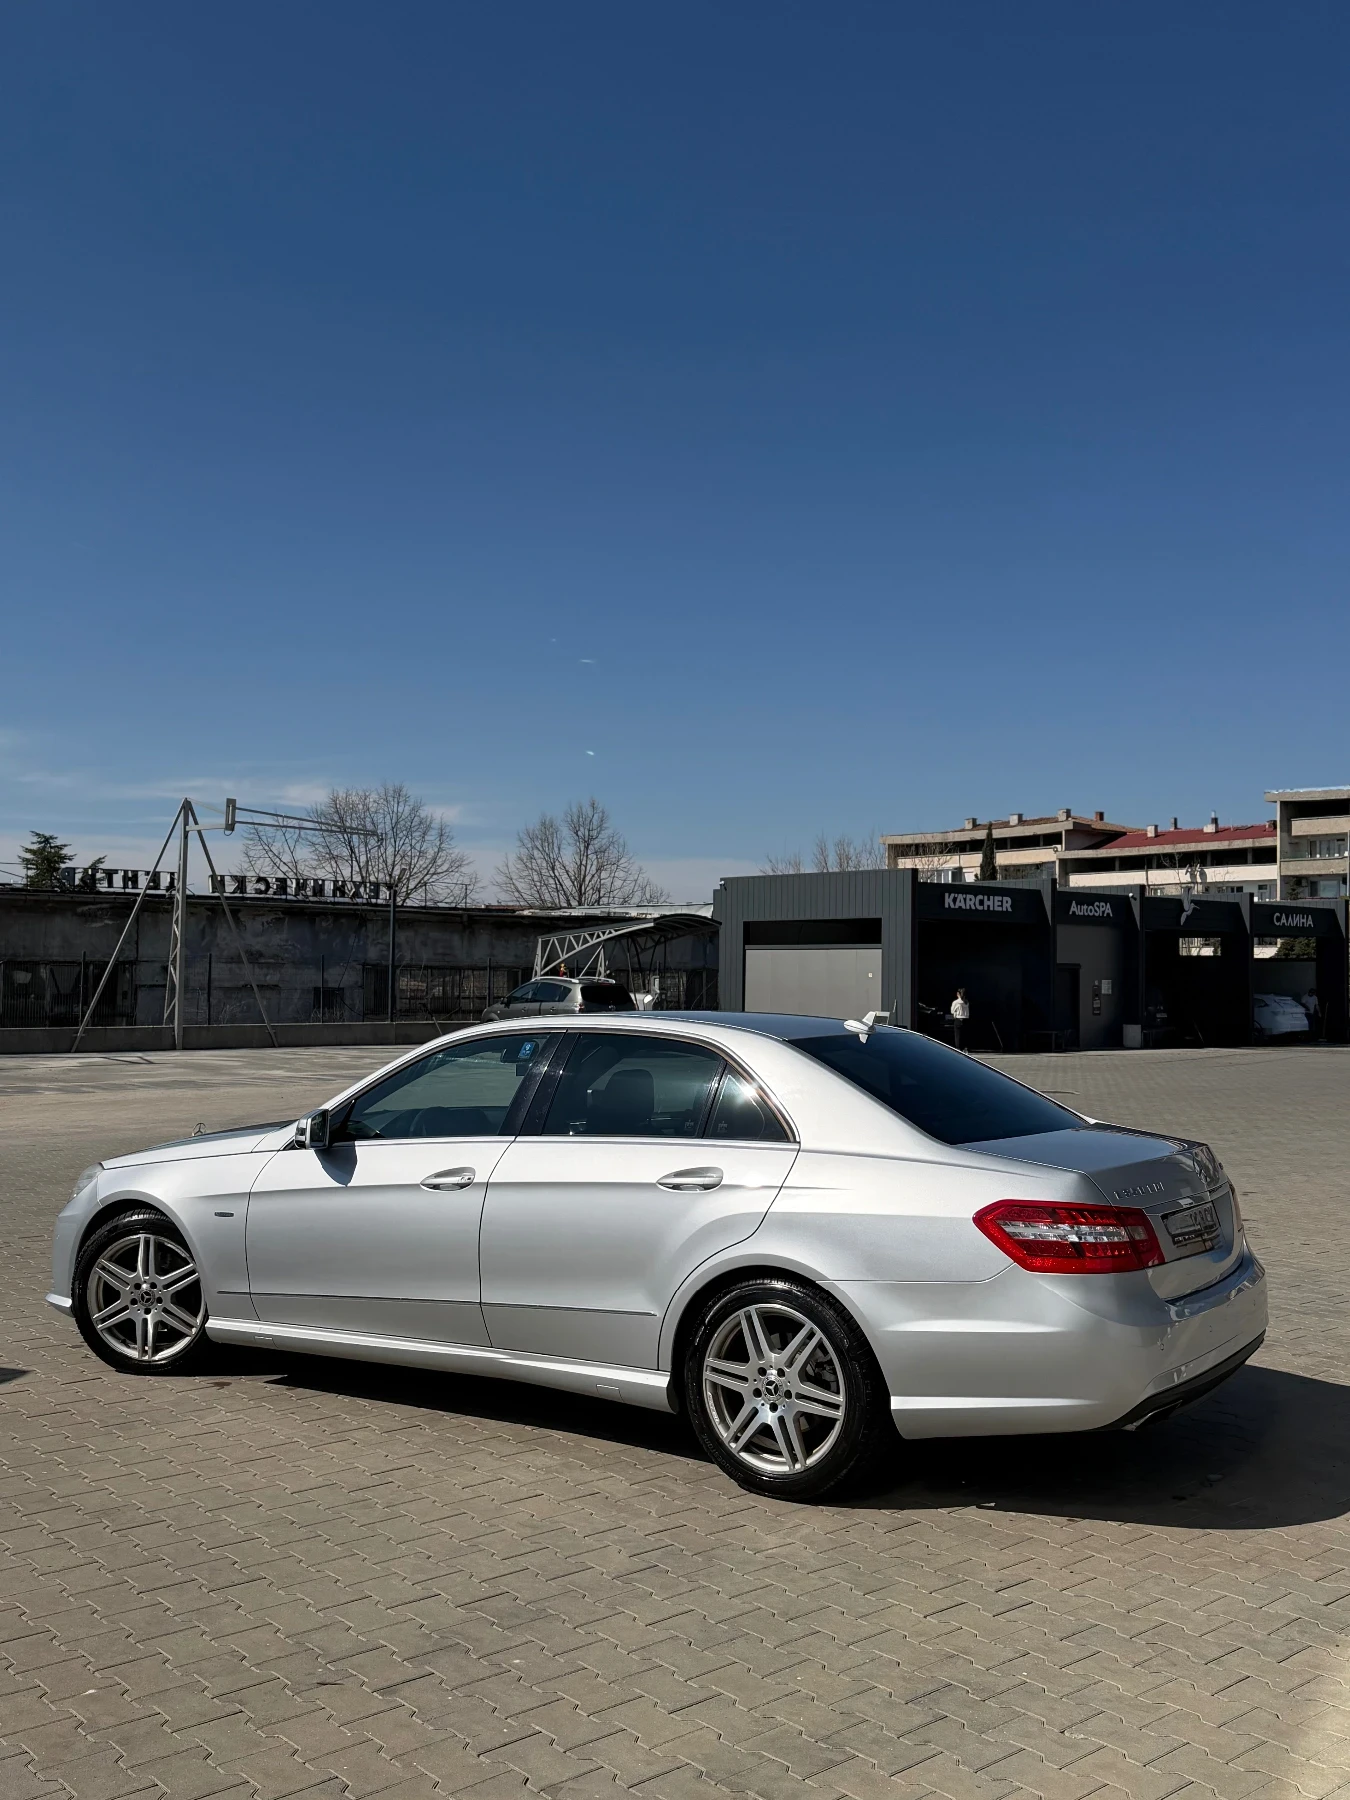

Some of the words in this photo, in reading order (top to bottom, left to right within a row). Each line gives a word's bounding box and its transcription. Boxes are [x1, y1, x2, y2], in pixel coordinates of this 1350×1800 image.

[944, 893, 1012, 912] KÄRCHER
[1069, 901, 1113, 917] AutoSPA
[1273, 912, 1314, 928] САЛИНА
